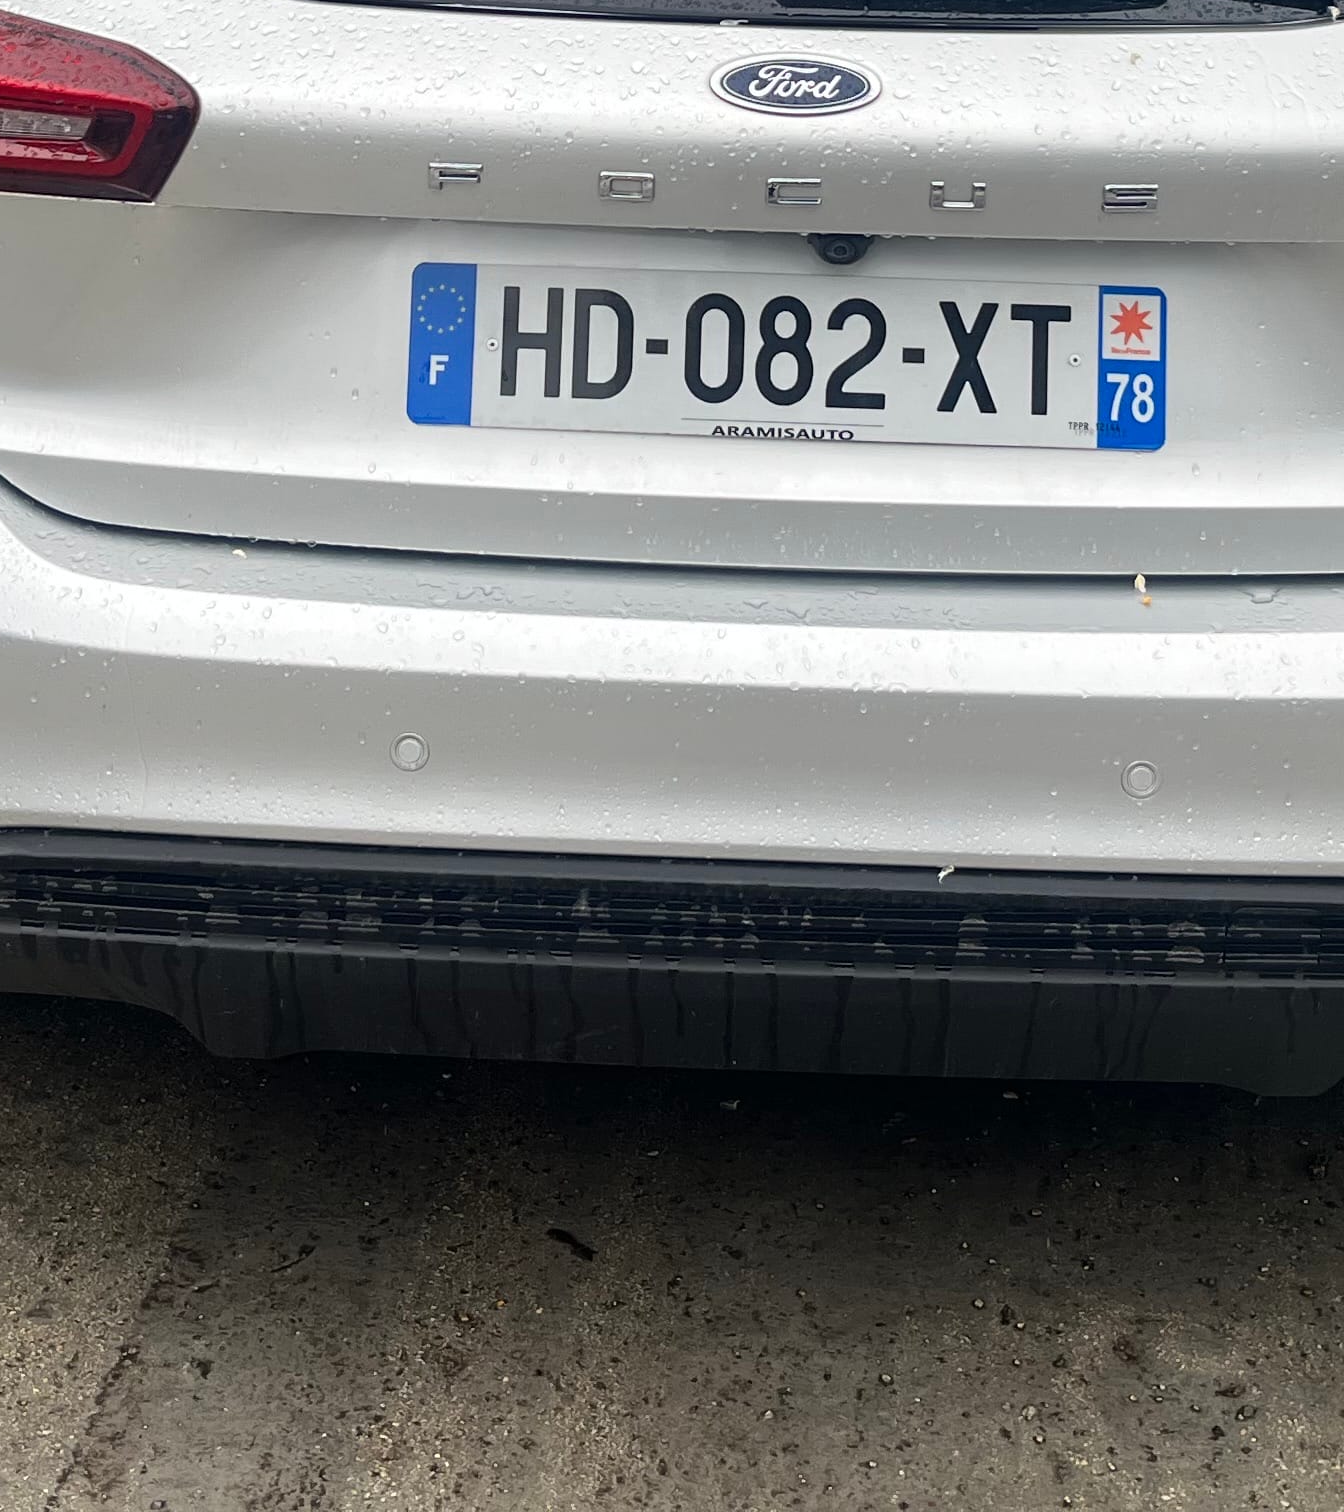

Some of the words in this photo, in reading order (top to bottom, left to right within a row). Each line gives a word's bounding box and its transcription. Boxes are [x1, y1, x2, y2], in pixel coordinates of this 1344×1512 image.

[749, 64, 842, 99] Ford
[428, 162, 1159, 212] FOCUS
[428, 354, 450, 386] F
[499, 285, 1072, 416] HD-082-XT
[1106, 372, 1155, 424] 78
[711, 425, 855, 440] ARAMISAUTO
